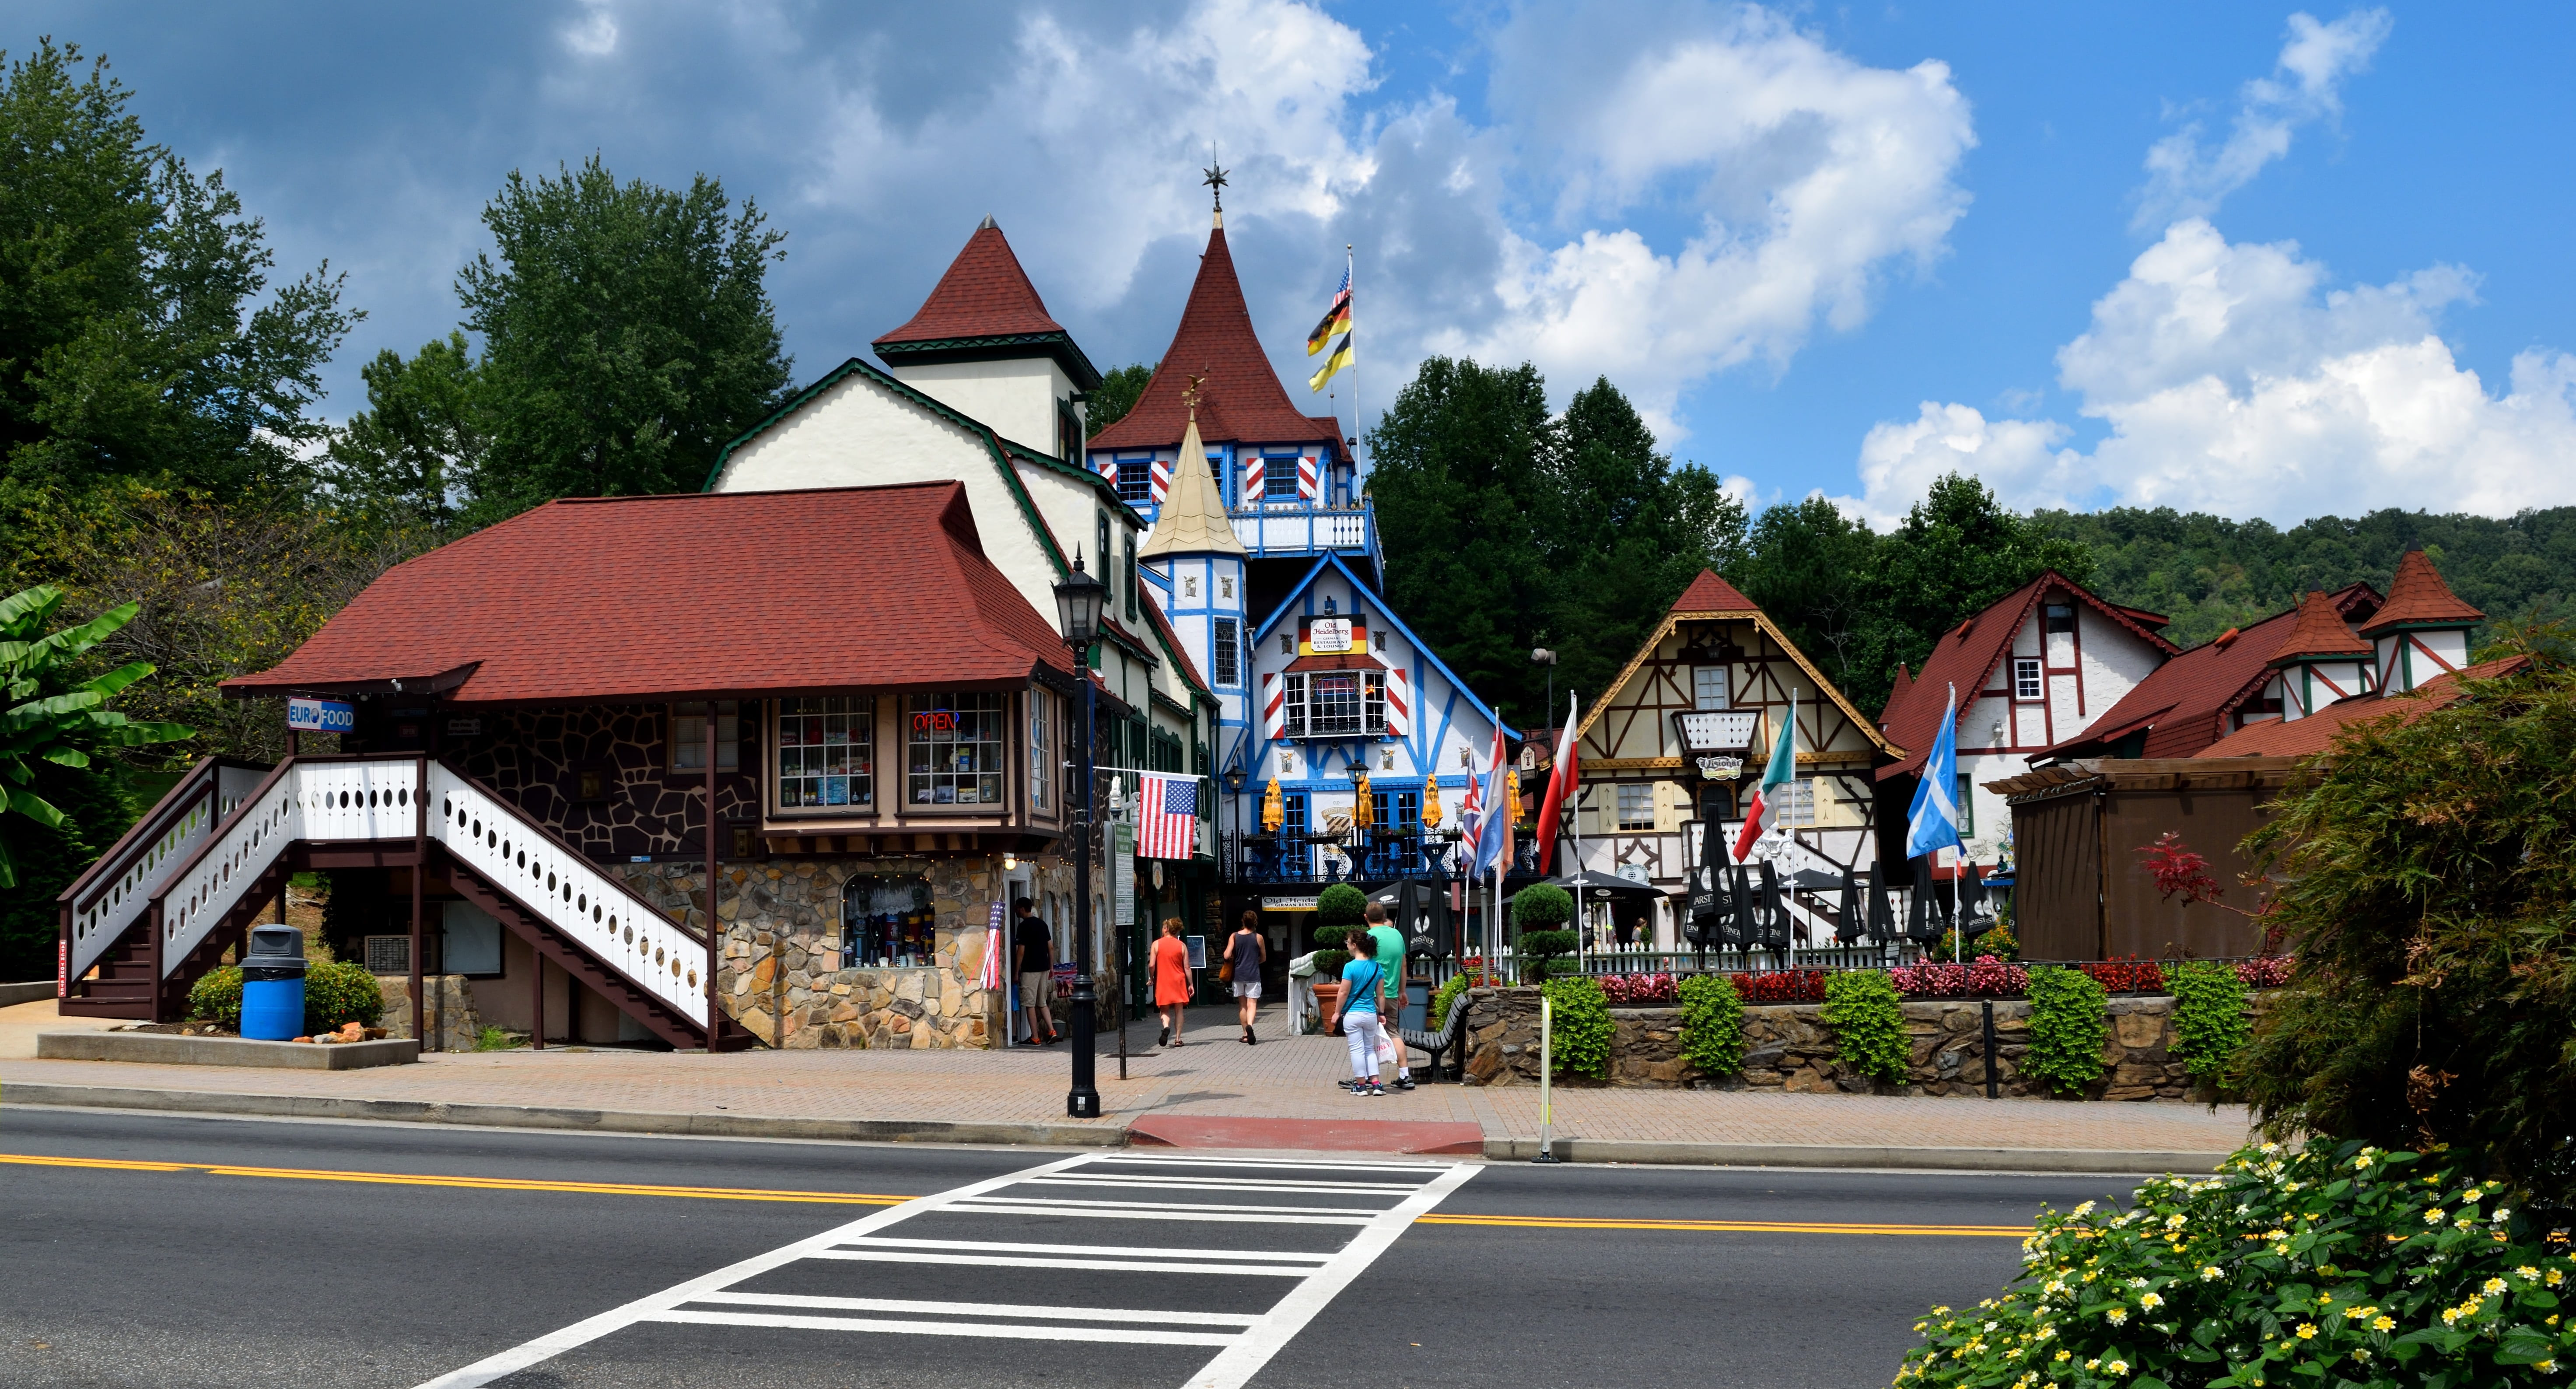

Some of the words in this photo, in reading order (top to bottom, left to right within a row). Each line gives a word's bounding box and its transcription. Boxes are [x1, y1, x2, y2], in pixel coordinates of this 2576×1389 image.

[1318, 679, 1354, 693] OPEN
[321, 709, 354, 726] FOOD
[914, 714, 955, 730] OPEN
[1698, 757, 1743, 768] Visionär
